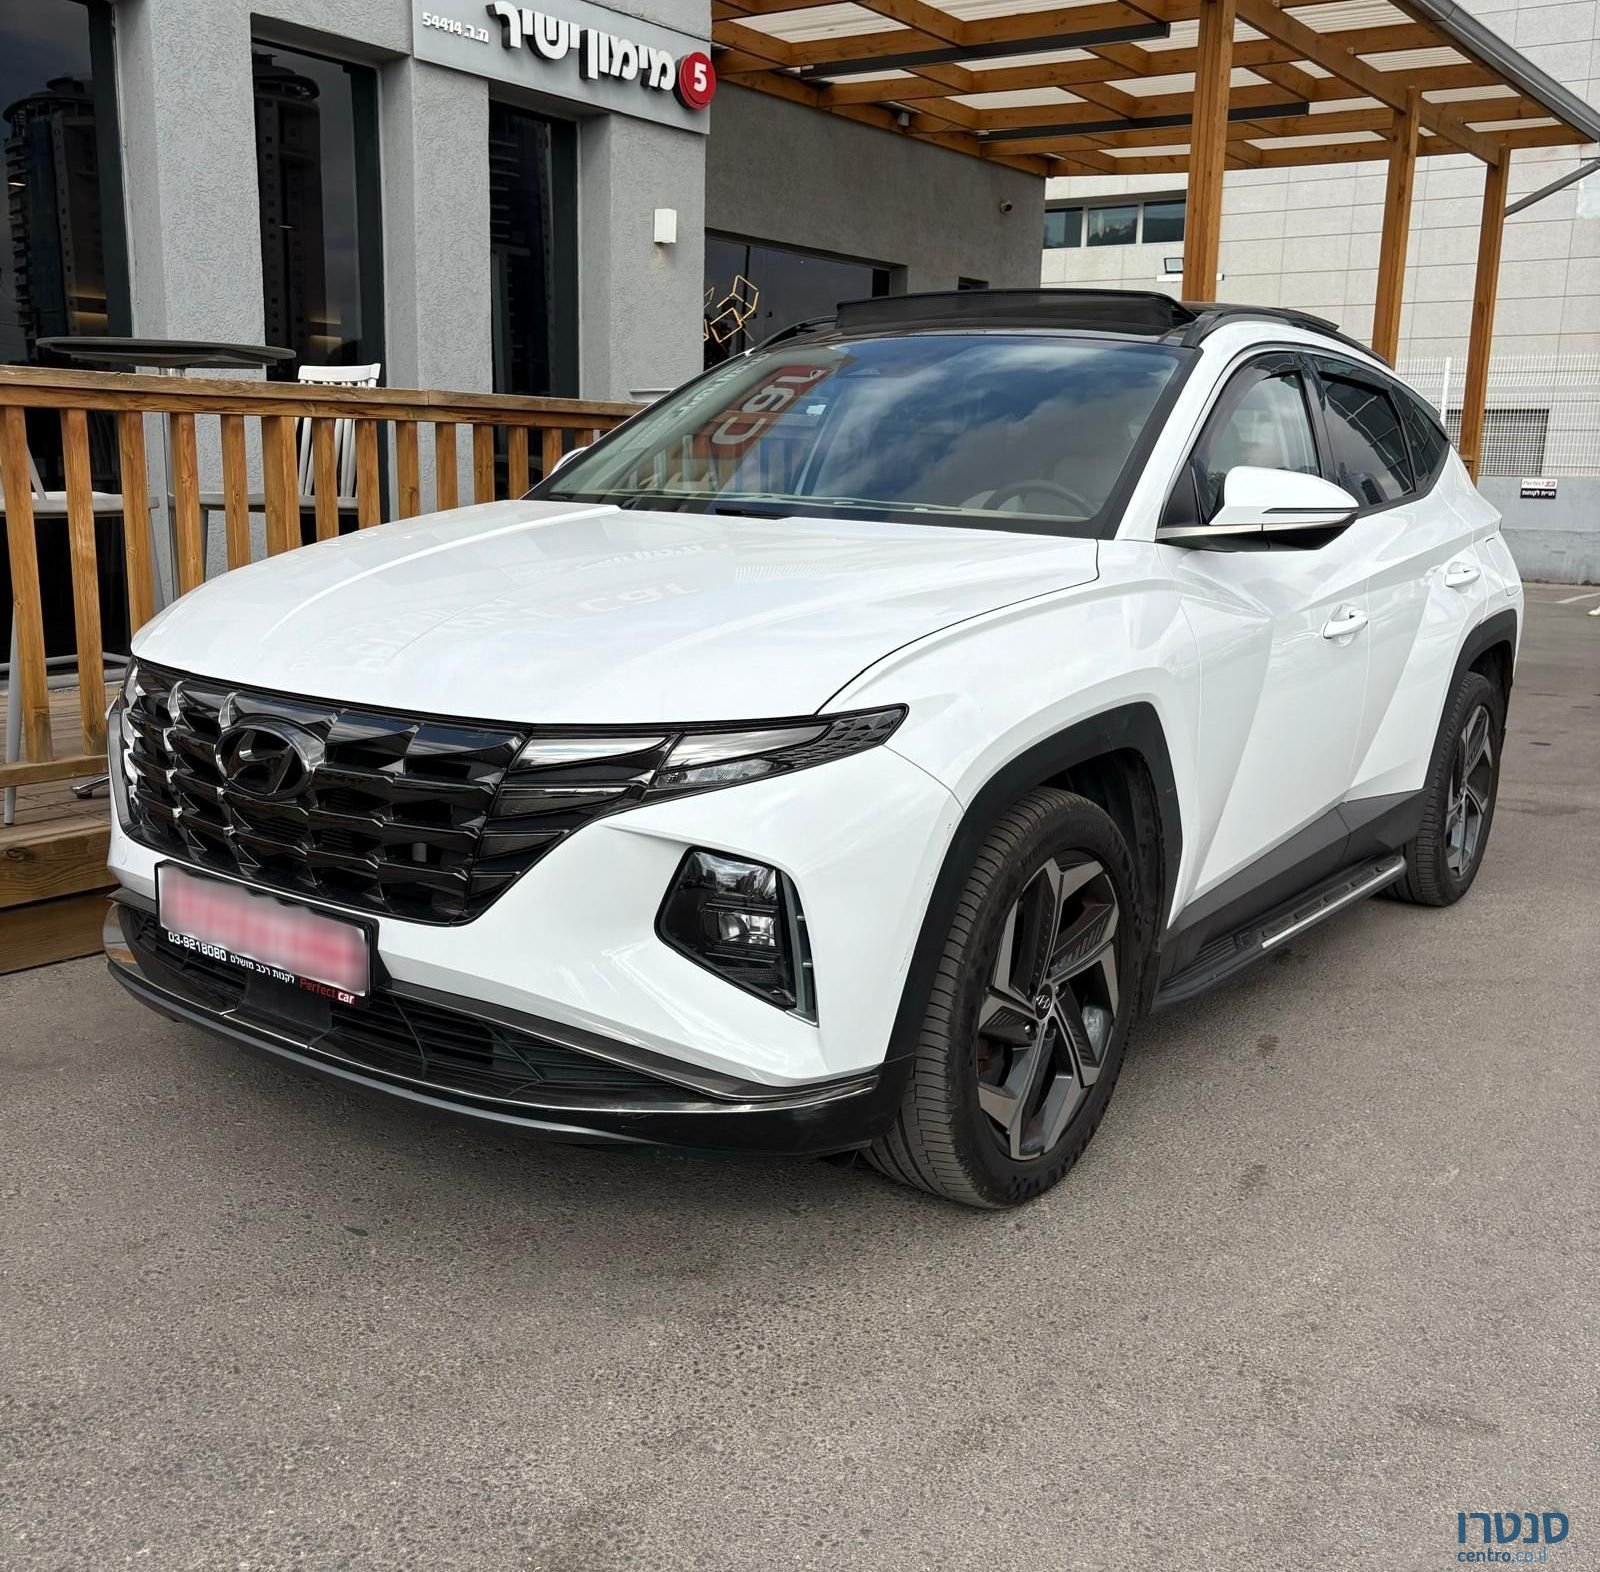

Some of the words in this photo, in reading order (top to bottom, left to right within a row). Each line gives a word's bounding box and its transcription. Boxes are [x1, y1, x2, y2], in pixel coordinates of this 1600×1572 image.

[422, 11, 463, 35] 54414
[486, 1, 581, 61] ישיר
[582, 28, 677, 92] מימון
[693, 62, 707, 92] 5
[230, 954, 255, 970] מושלם
[255, 963, 271, 976] רכב
[272, 969, 295, 984] לקנות
[300, 978, 337, 999] Perfect
[337, 991, 355, 1005] car
